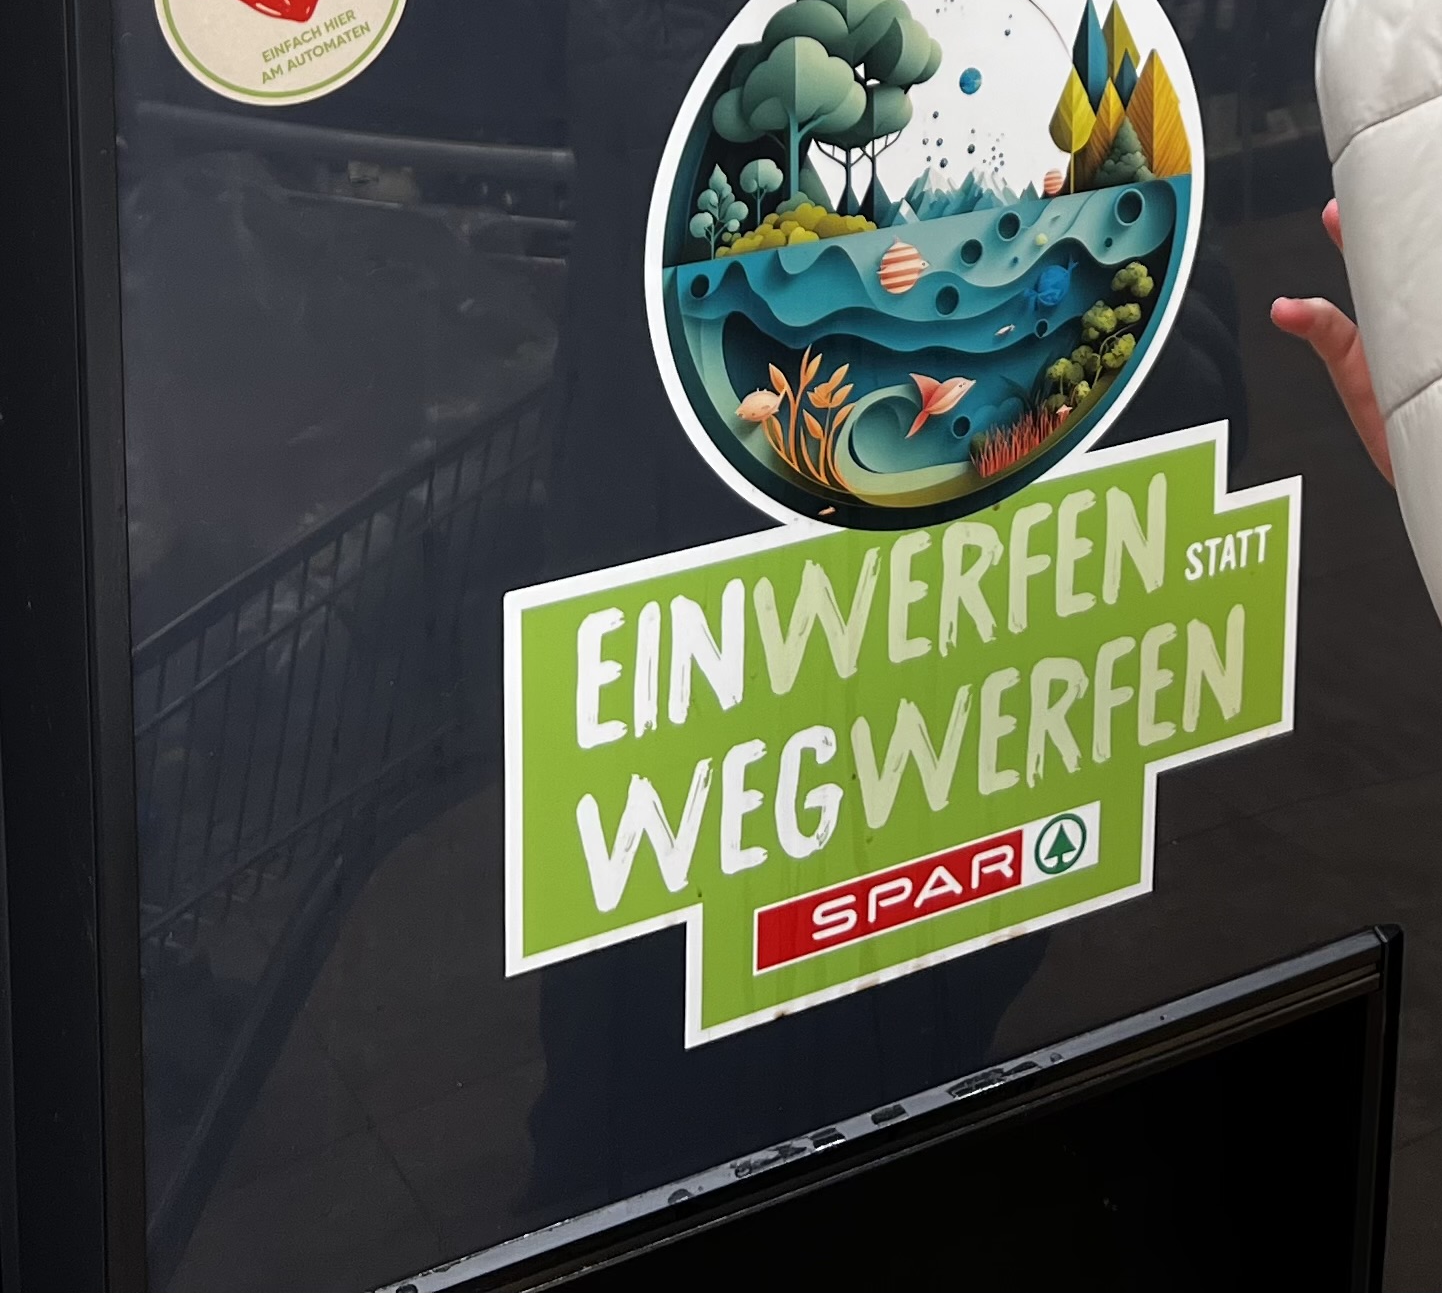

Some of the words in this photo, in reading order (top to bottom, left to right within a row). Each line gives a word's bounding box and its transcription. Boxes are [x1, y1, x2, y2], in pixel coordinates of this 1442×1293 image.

[261, 24, 322, 64] EINFACH
[325, 8, 357, 35] HIER
[261, 63, 284, 85] AM
[287, 21, 372, 72] AUTOMATEN
[575, 471, 1168, 751] EINWERFEN
[1183, 523, 1273, 582] STATT
[574, 602, 1247, 914] WEGWERFEN
[810, 841, 1017, 944] SPAR
